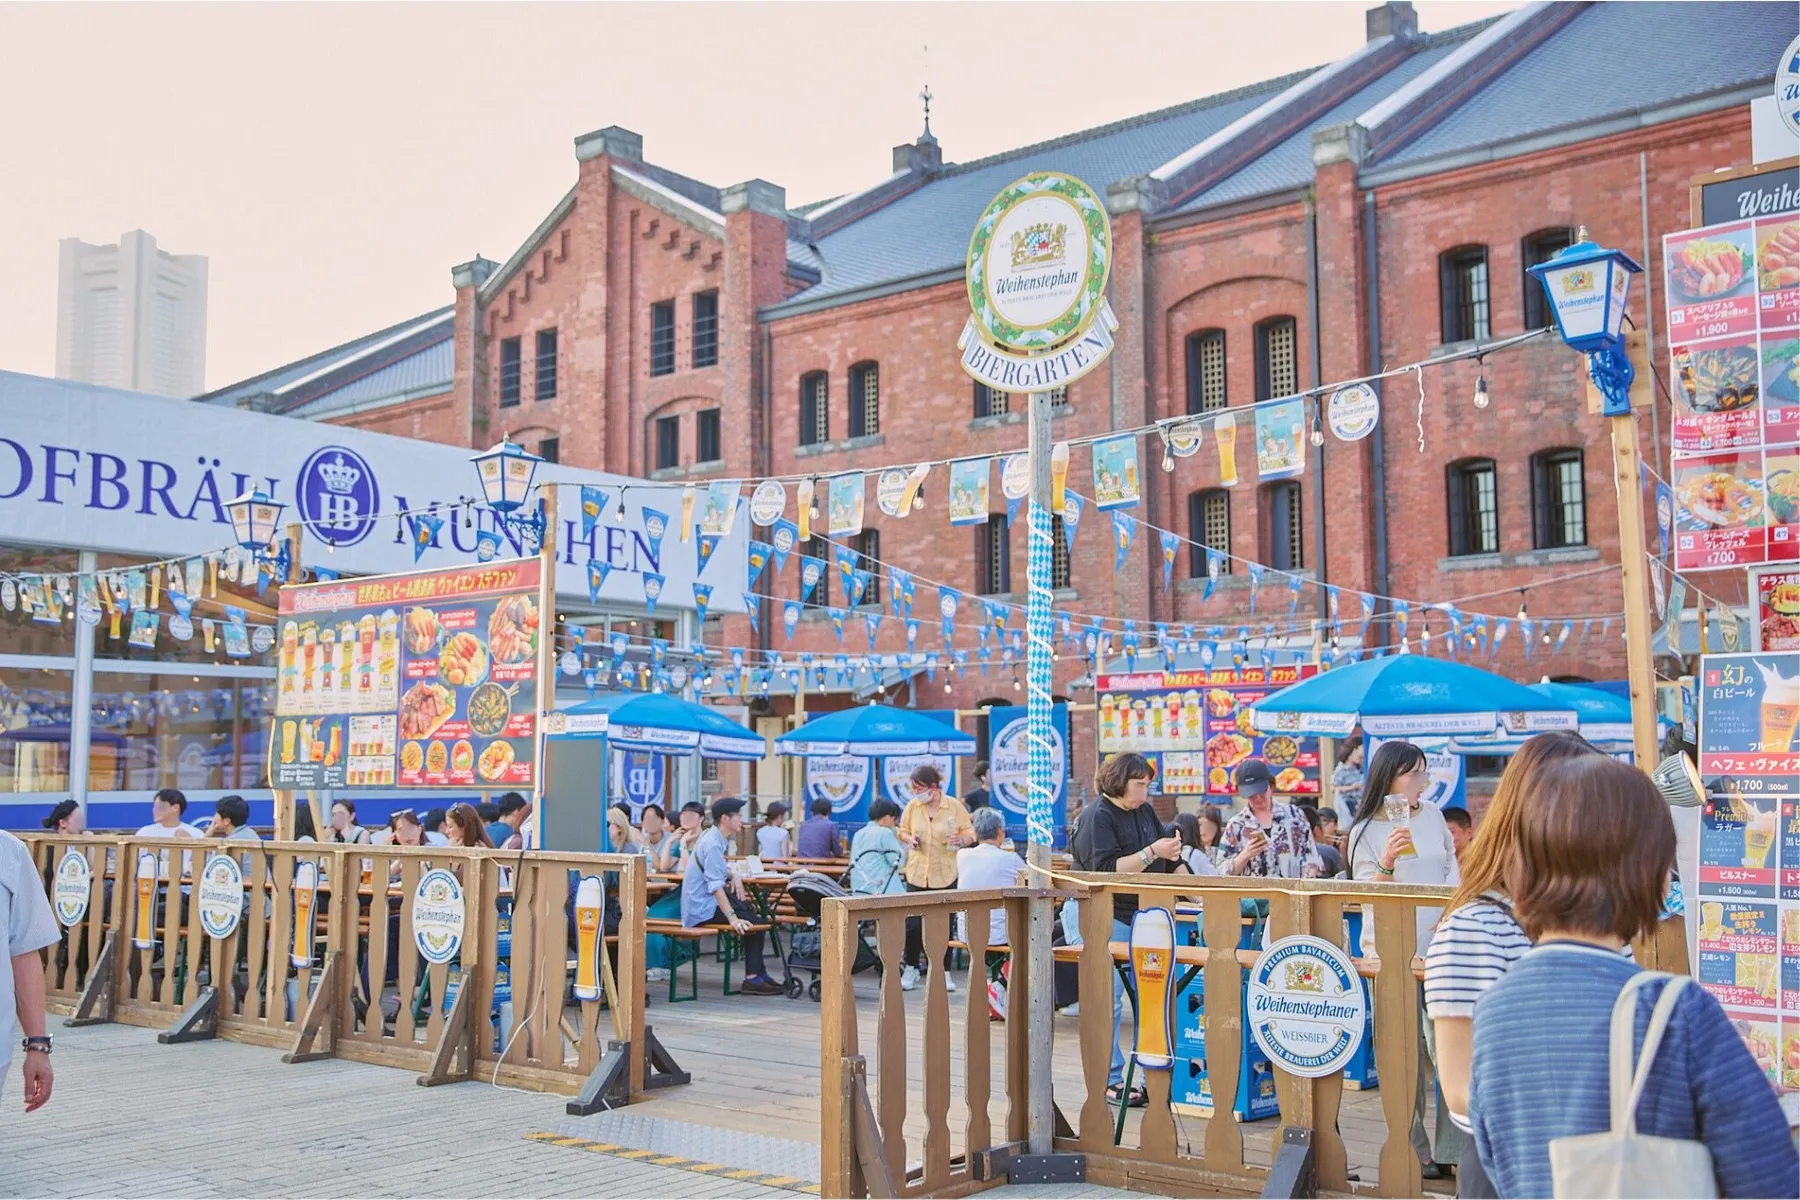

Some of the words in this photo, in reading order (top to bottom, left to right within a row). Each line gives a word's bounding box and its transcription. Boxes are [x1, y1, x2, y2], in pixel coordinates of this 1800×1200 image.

[996, 269, 1078, 295] Weihenstephan
[968, 330, 1108, 387] BIERGARTEN
[320, 492, 360, 530] HB
[393, 494, 662, 574] MÜNHEN
[1707, 550, 1736, 564] ¥700
[1721, 663, 1754, 686] 幻の
[1713, 686, 1756, 700] 白ビール
[1715, 823, 1742, 833] ラガー
[1720, 935, 1775, 944] こだわりのレモンサワー
[1742, 927, 1762, 935] レモン
[1264, 946, 1300, 973] PREMIUM
[1301, 945, 1345, 978] BAVARICUM
[1255, 994, 1359, 1019] Weihenstephaner
[1281, 1029, 1329, 1044] WEISSBIER
[1284, 1051, 1320, 1067] BRAUEREI
[1320, 1051, 1336, 1064] DER
[1333, 1036, 1349, 1056] WELT
